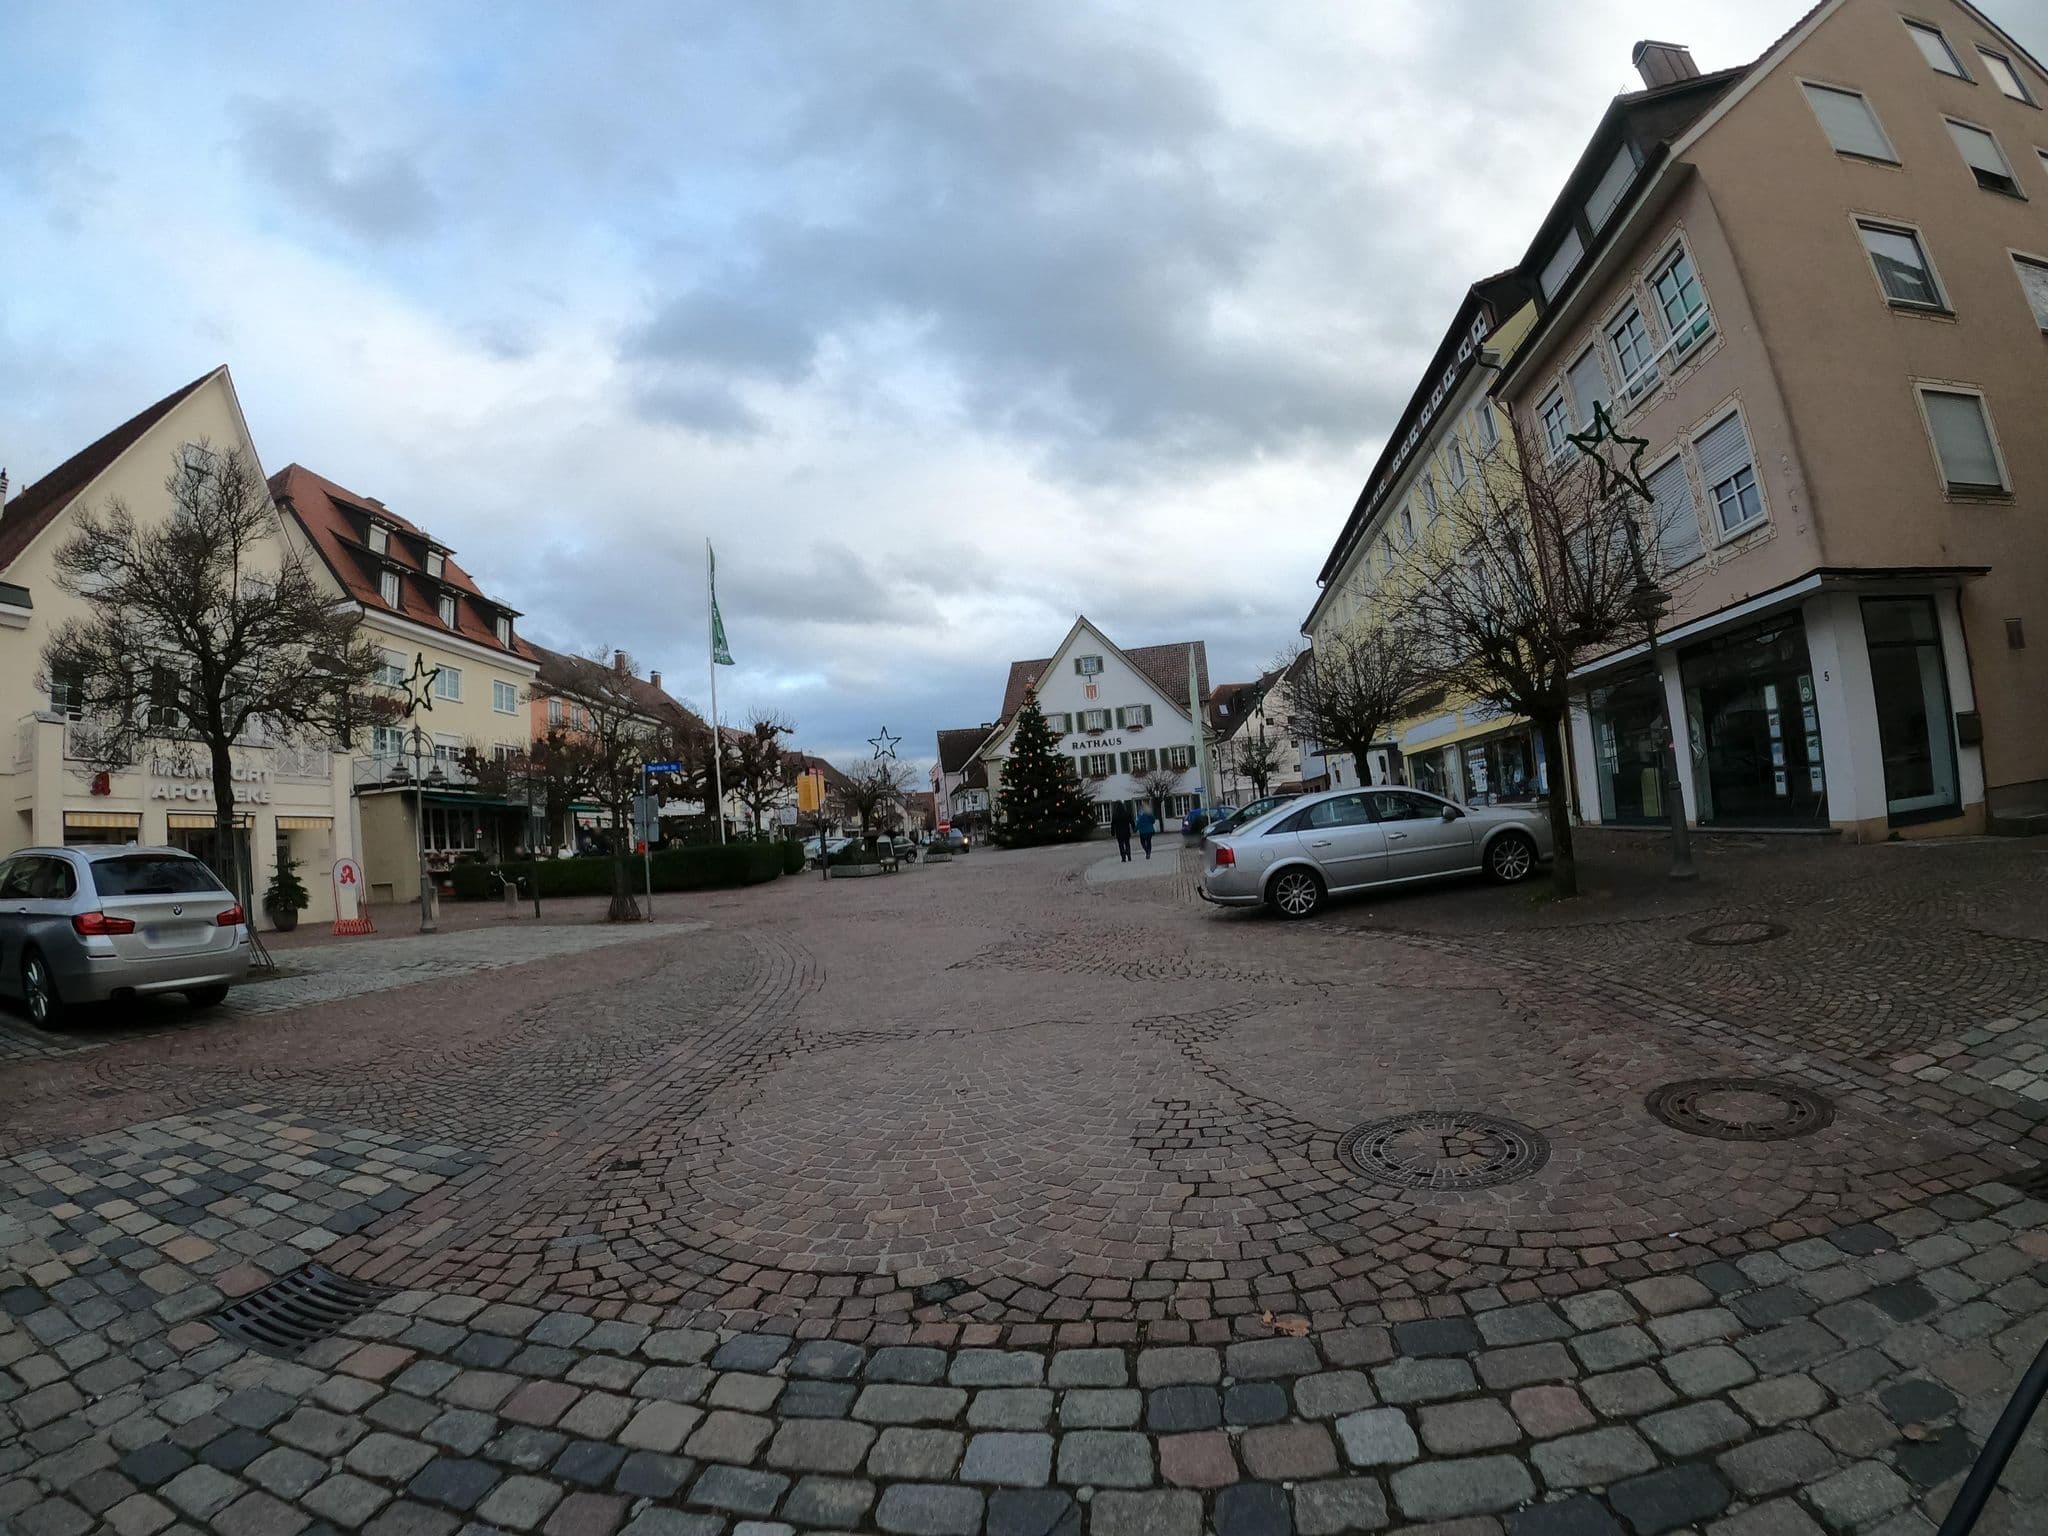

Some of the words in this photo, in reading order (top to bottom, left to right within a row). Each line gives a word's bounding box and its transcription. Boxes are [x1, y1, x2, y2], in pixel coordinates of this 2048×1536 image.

[1824, 671, 1830, 682] 5
[1072, 737, 1122, 750] RATHAUS
[151, 759, 274, 782] MONTORT
[151, 785, 273, 804] APOTEKE
[340, 864, 356, 885] A
